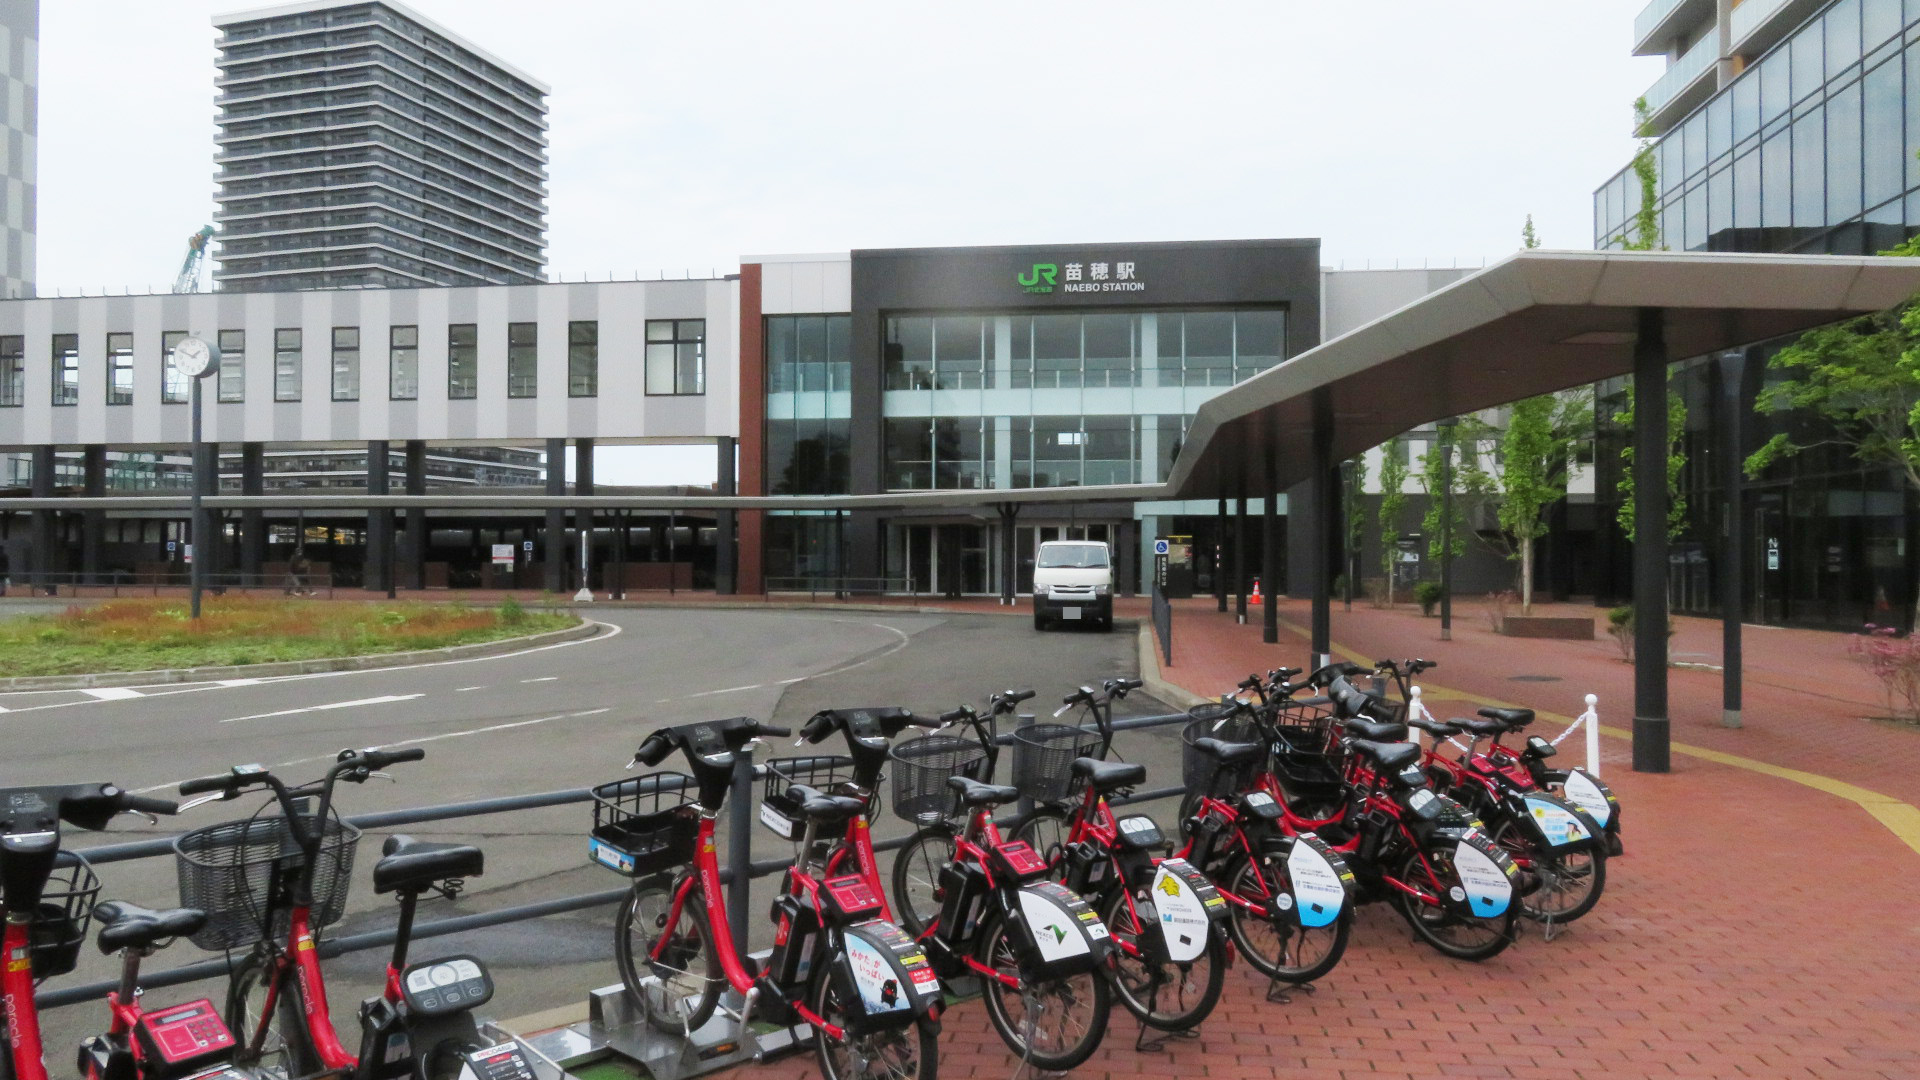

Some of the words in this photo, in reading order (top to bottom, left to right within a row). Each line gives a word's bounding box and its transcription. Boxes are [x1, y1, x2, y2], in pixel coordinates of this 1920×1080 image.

[1018, 263, 1058, 286] JR
[1065, 262, 1135, 281] 苗穂駅
[1064, 283, 1100, 293] NAEBO
[1102, 282, 1145, 292] STATION
[701, 869, 714, 908] porocle
[297, 965, 315, 1014] porocle
[6, 994, 23, 1048] porocle
